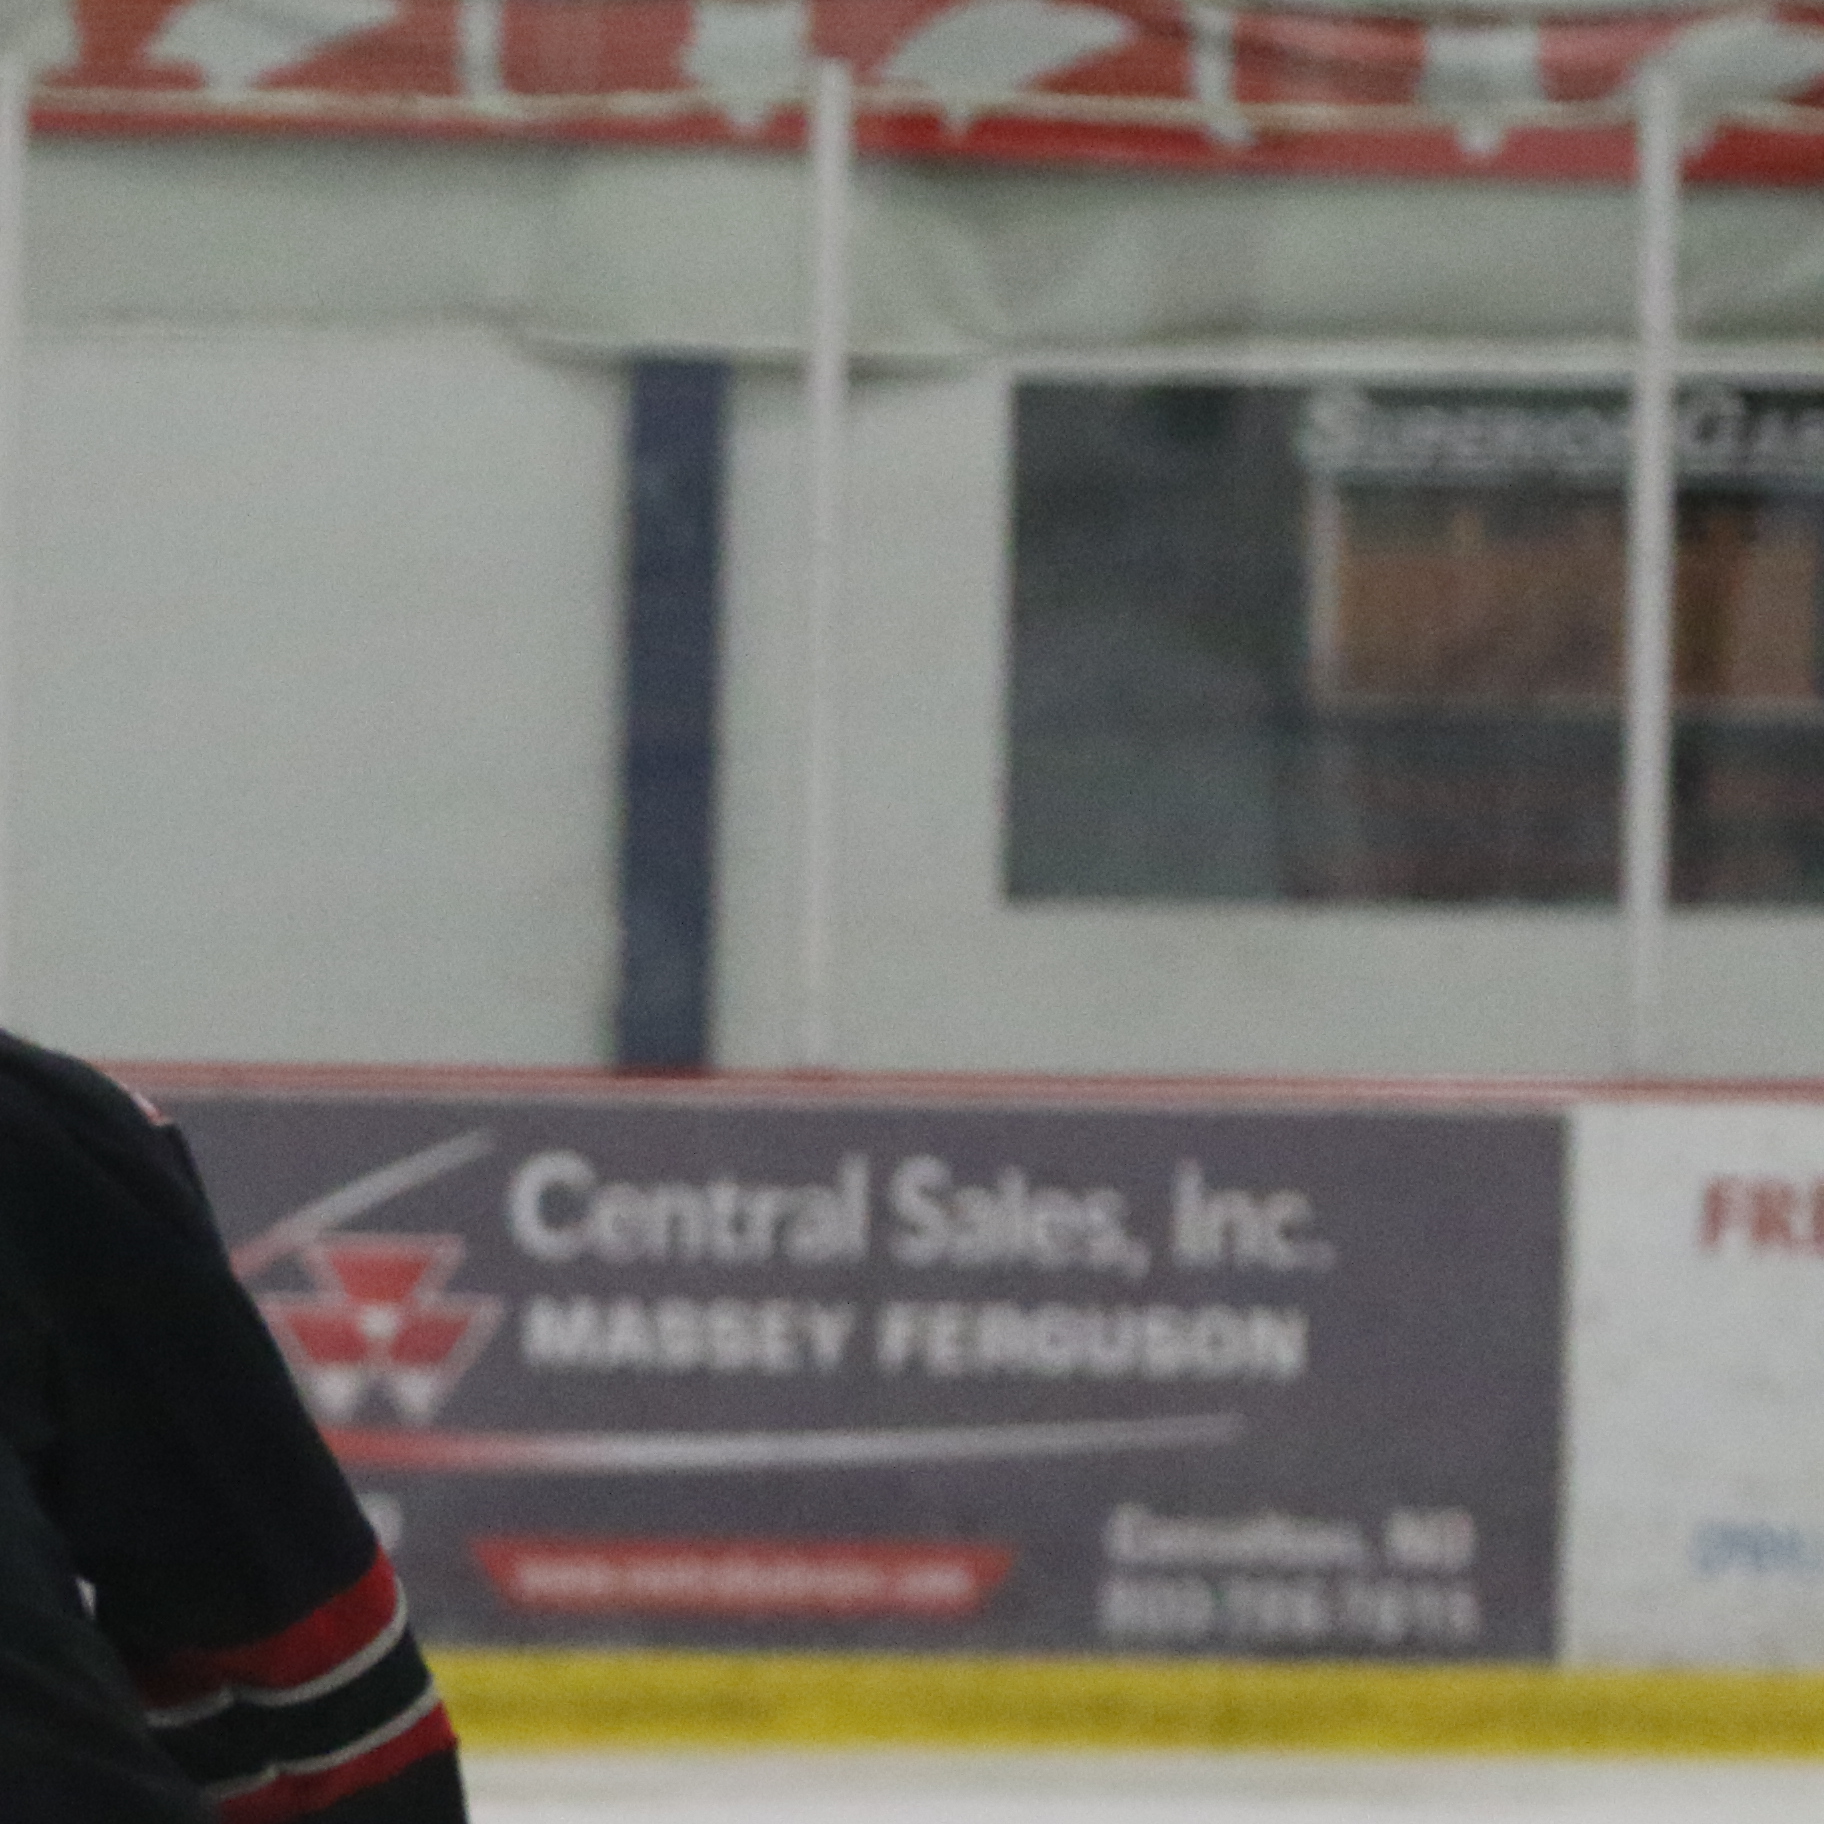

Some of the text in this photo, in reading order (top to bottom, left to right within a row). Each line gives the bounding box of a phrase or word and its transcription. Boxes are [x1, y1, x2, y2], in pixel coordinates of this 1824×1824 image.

[505, 1149, 1336, 1276] Central Sales, Inc.
[520, 1297, 1310, 1379] MASSEY FERGUSON
